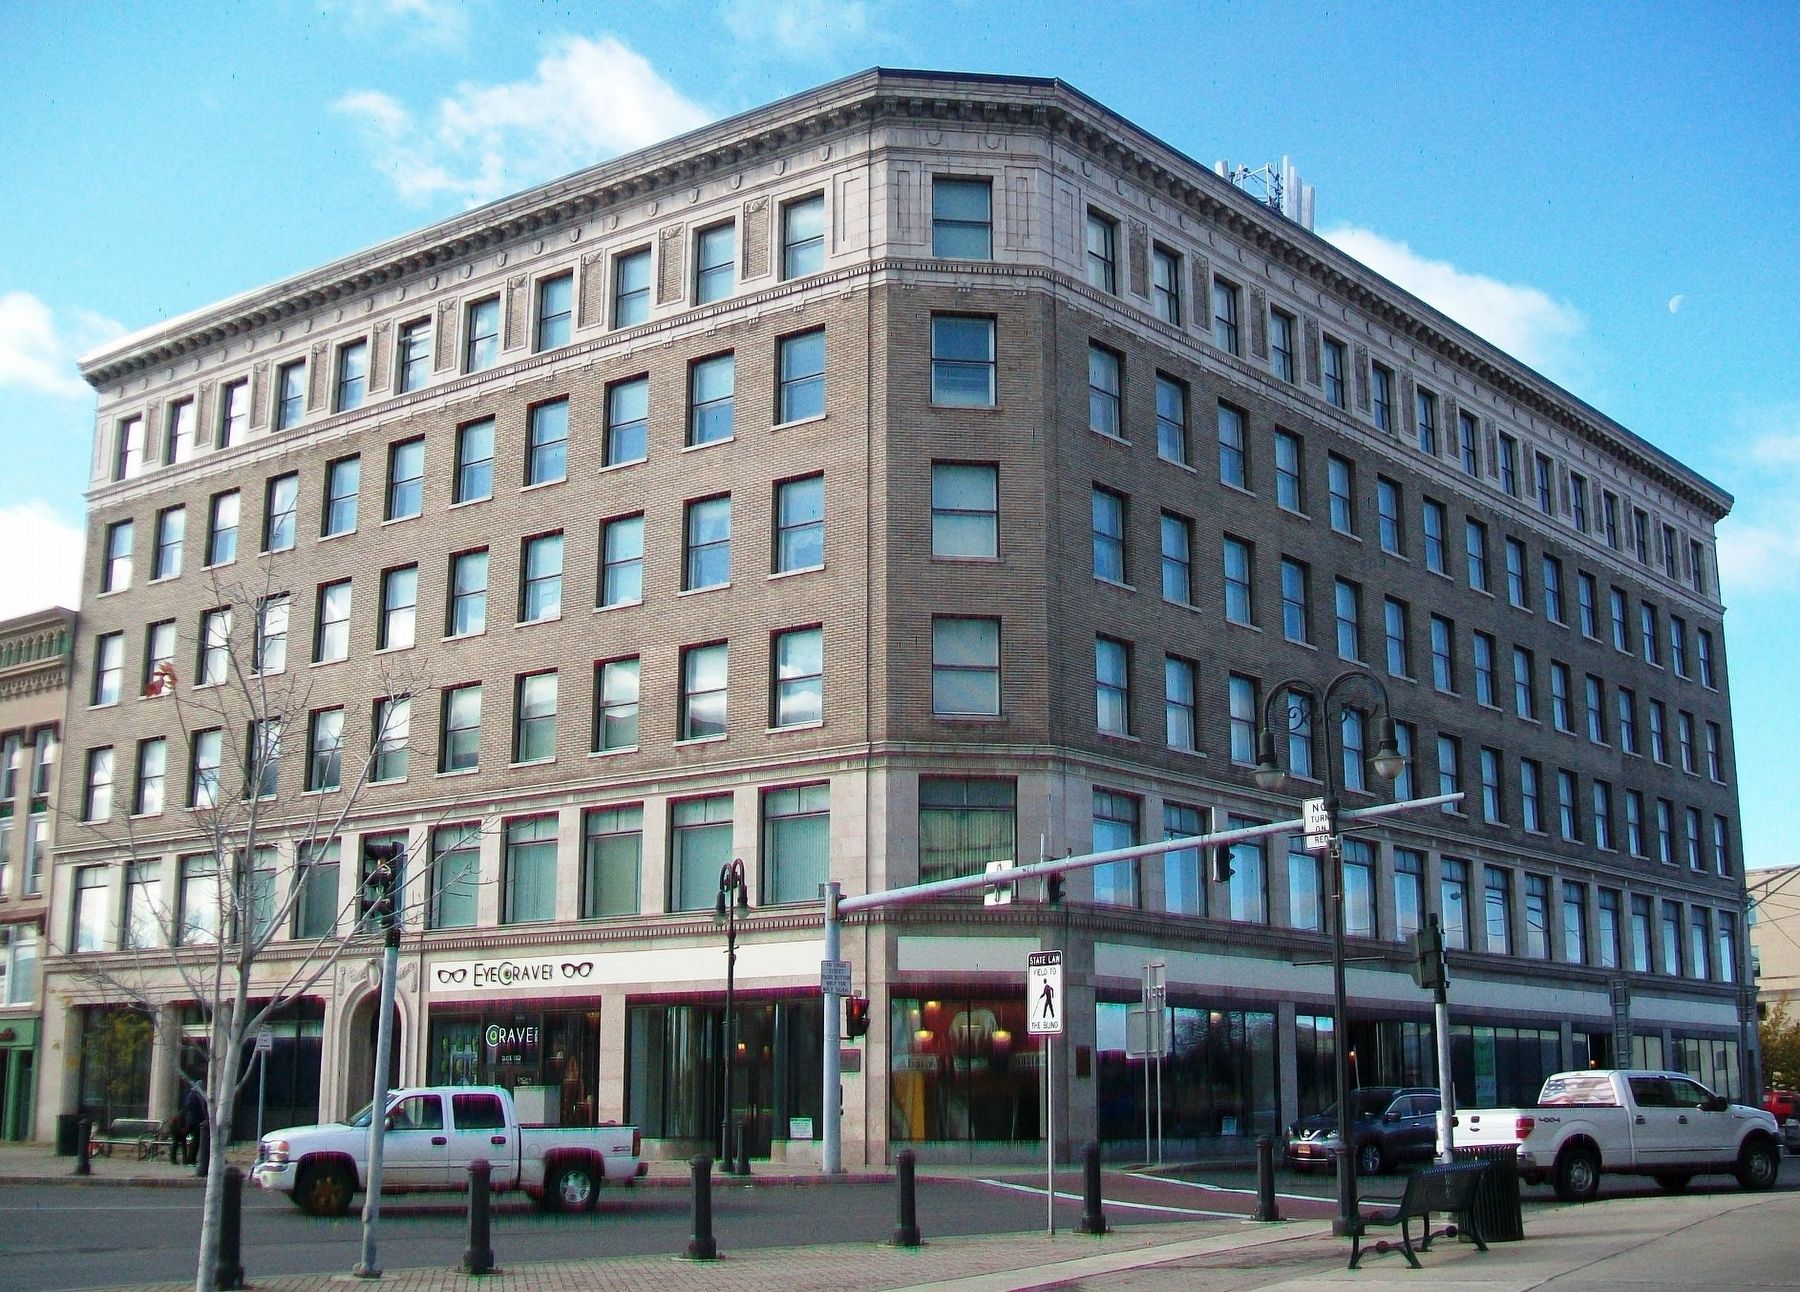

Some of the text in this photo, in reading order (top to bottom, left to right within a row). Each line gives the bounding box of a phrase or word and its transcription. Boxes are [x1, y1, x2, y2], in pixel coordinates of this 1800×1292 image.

[1314, 835, 1329, 843] RED
[1029, 955, 1060, 965] STATE LAW
[1033, 967, 1057, 976] YIELD TO
[1031, 1021, 1058, 1030] THE BLIND
